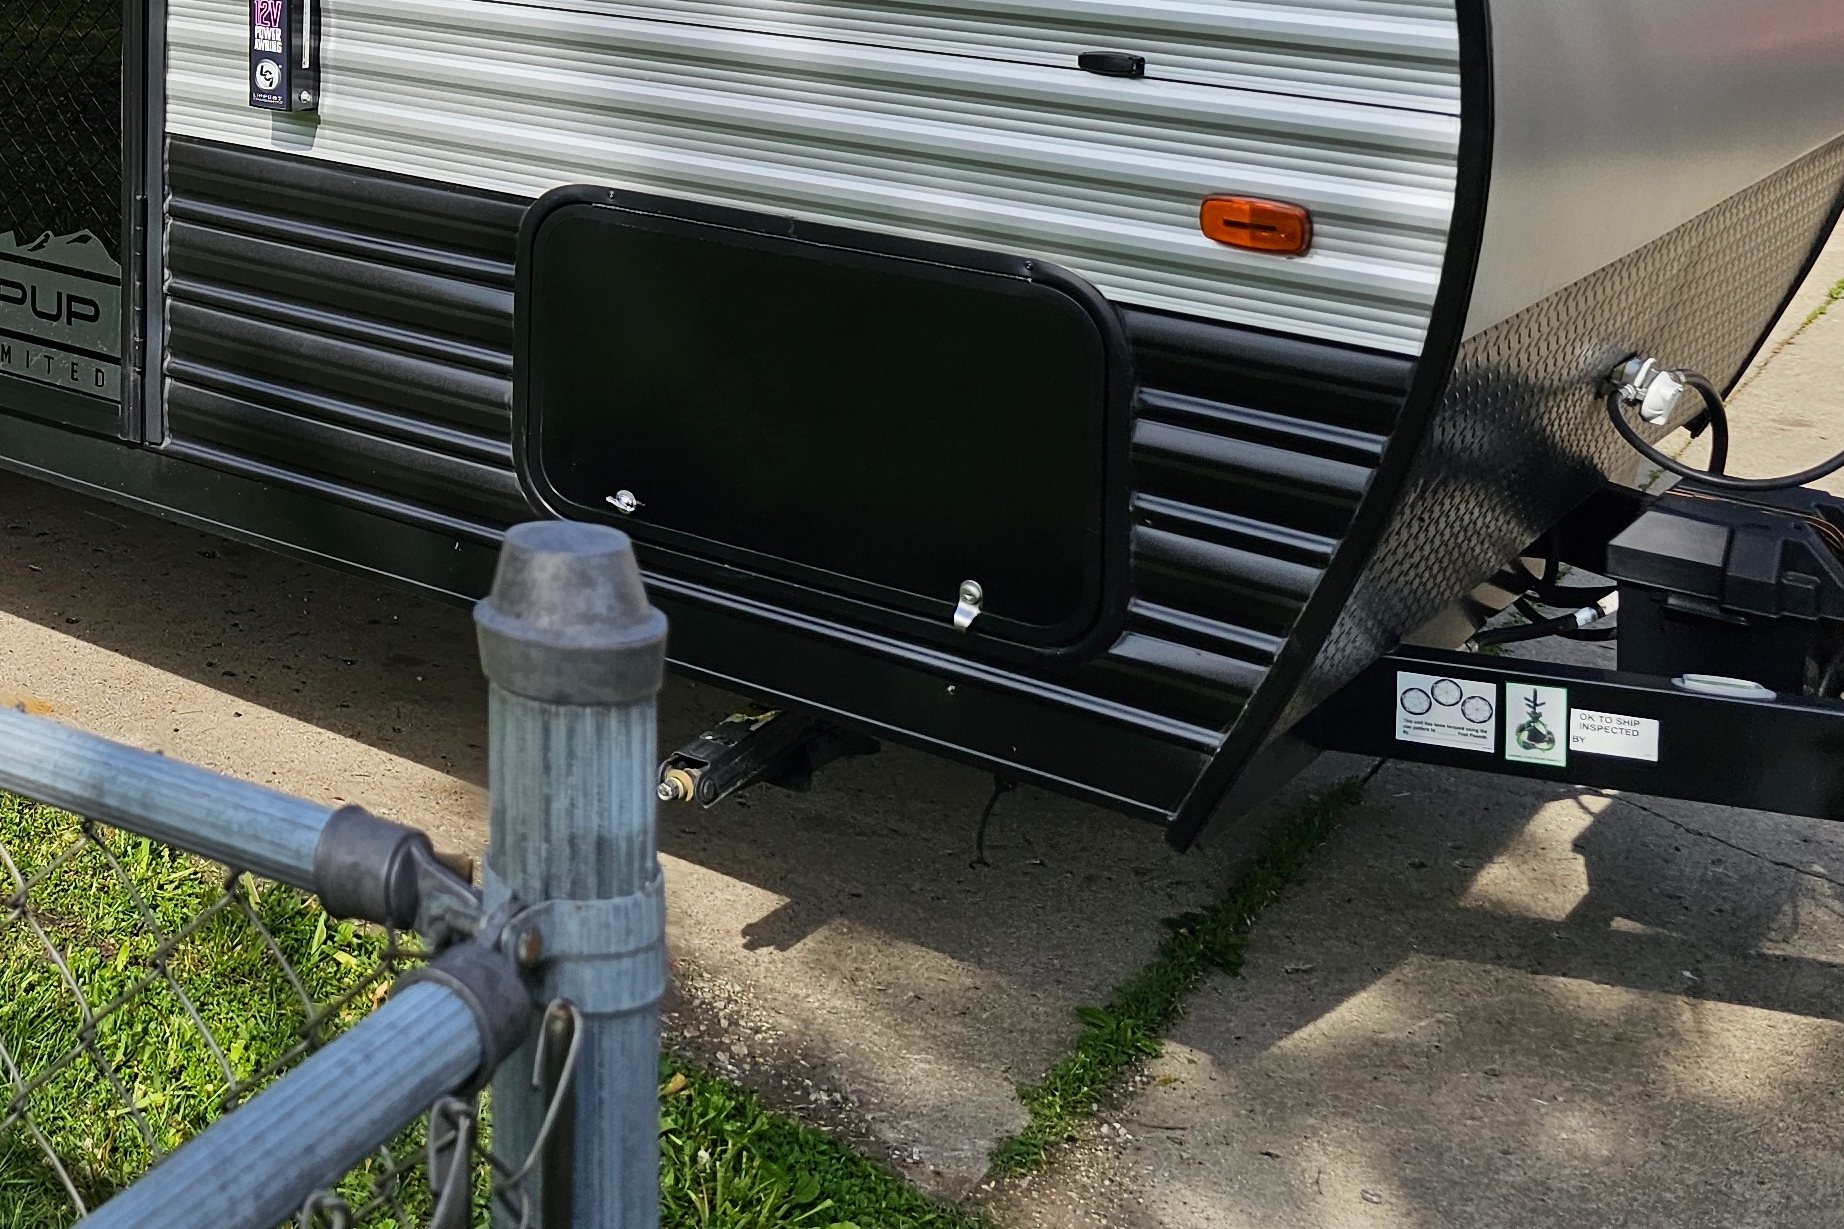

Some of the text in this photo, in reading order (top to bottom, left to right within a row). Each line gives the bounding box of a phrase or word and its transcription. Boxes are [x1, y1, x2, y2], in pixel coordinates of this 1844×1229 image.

[255, 26, 282, 41] POWER
[1579, 713, 1641, 727] OK TO SHIP
[1579, 722, 1640, 737] INSPECTED
[1572, 735, 1586, 743] BY
